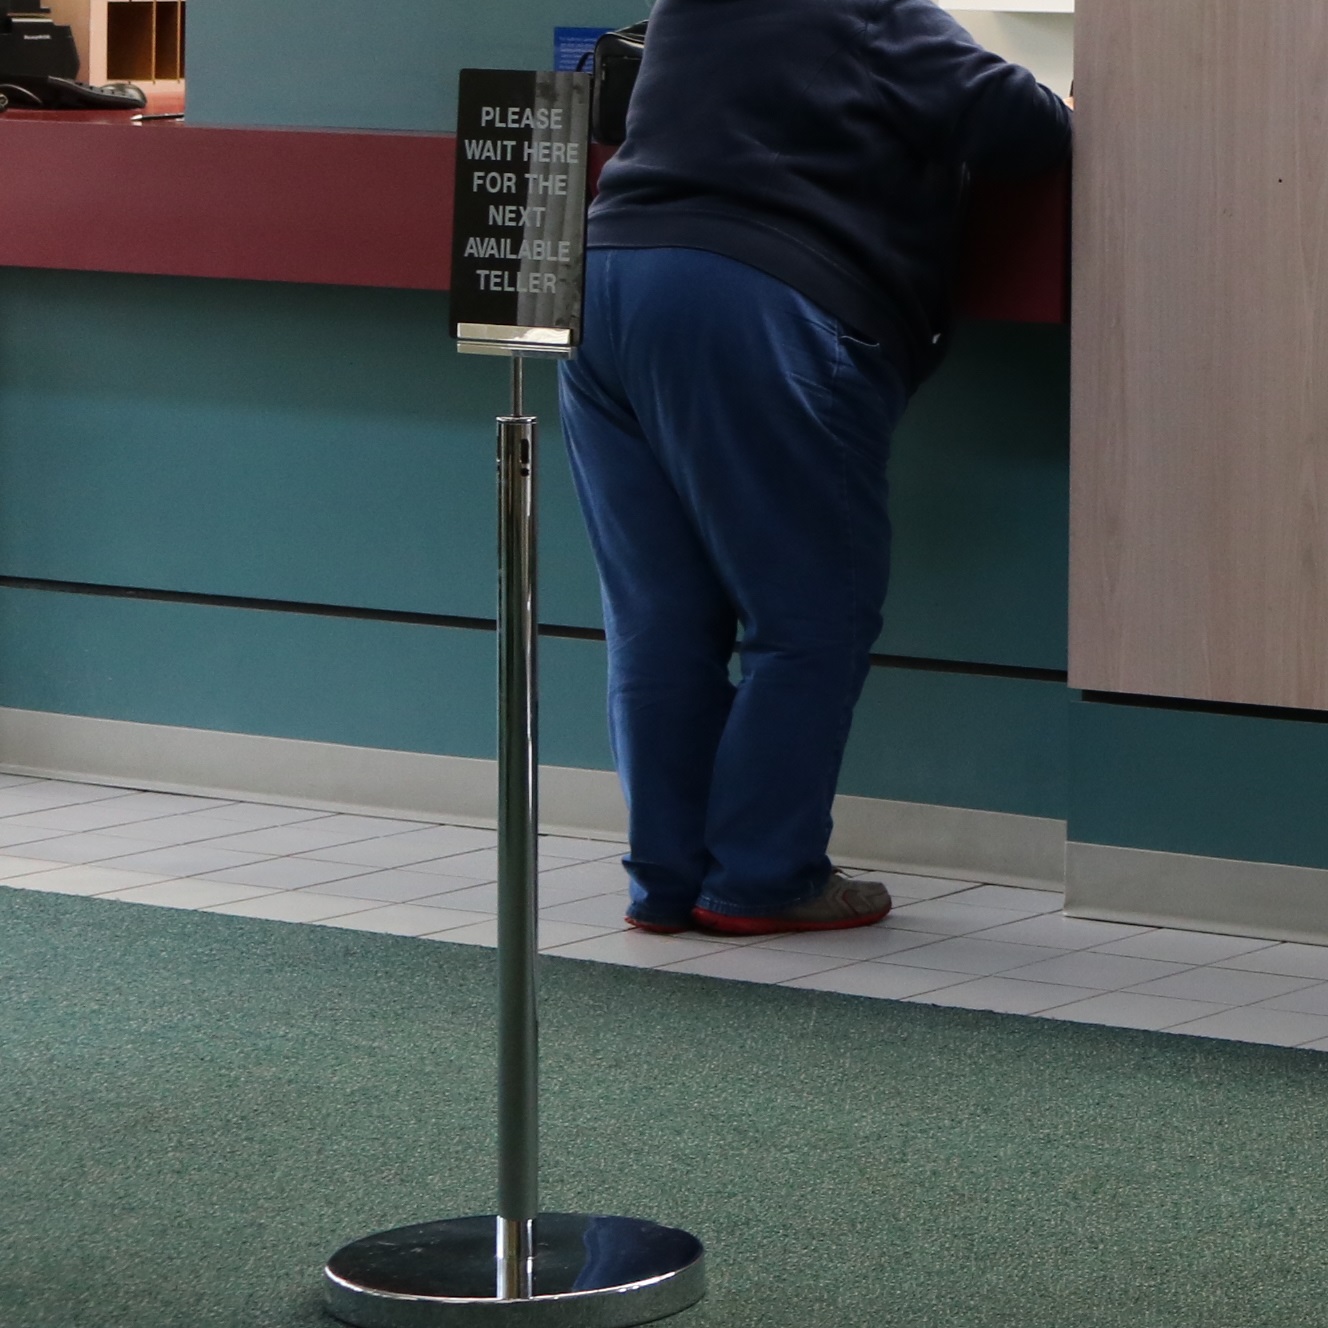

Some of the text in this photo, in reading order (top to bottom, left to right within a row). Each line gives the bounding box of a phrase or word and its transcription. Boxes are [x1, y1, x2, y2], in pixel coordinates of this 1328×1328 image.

[481, 106, 563, 130] PLEASE
[464, 139, 579, 164] WAIT HERE
[472, 172, 568, 196] FOR THE
[488, 205, 546, 227] NEXT
[464, 237, 571, 262] AVAILABLE
[476, 269, 557, 294] TELLER
